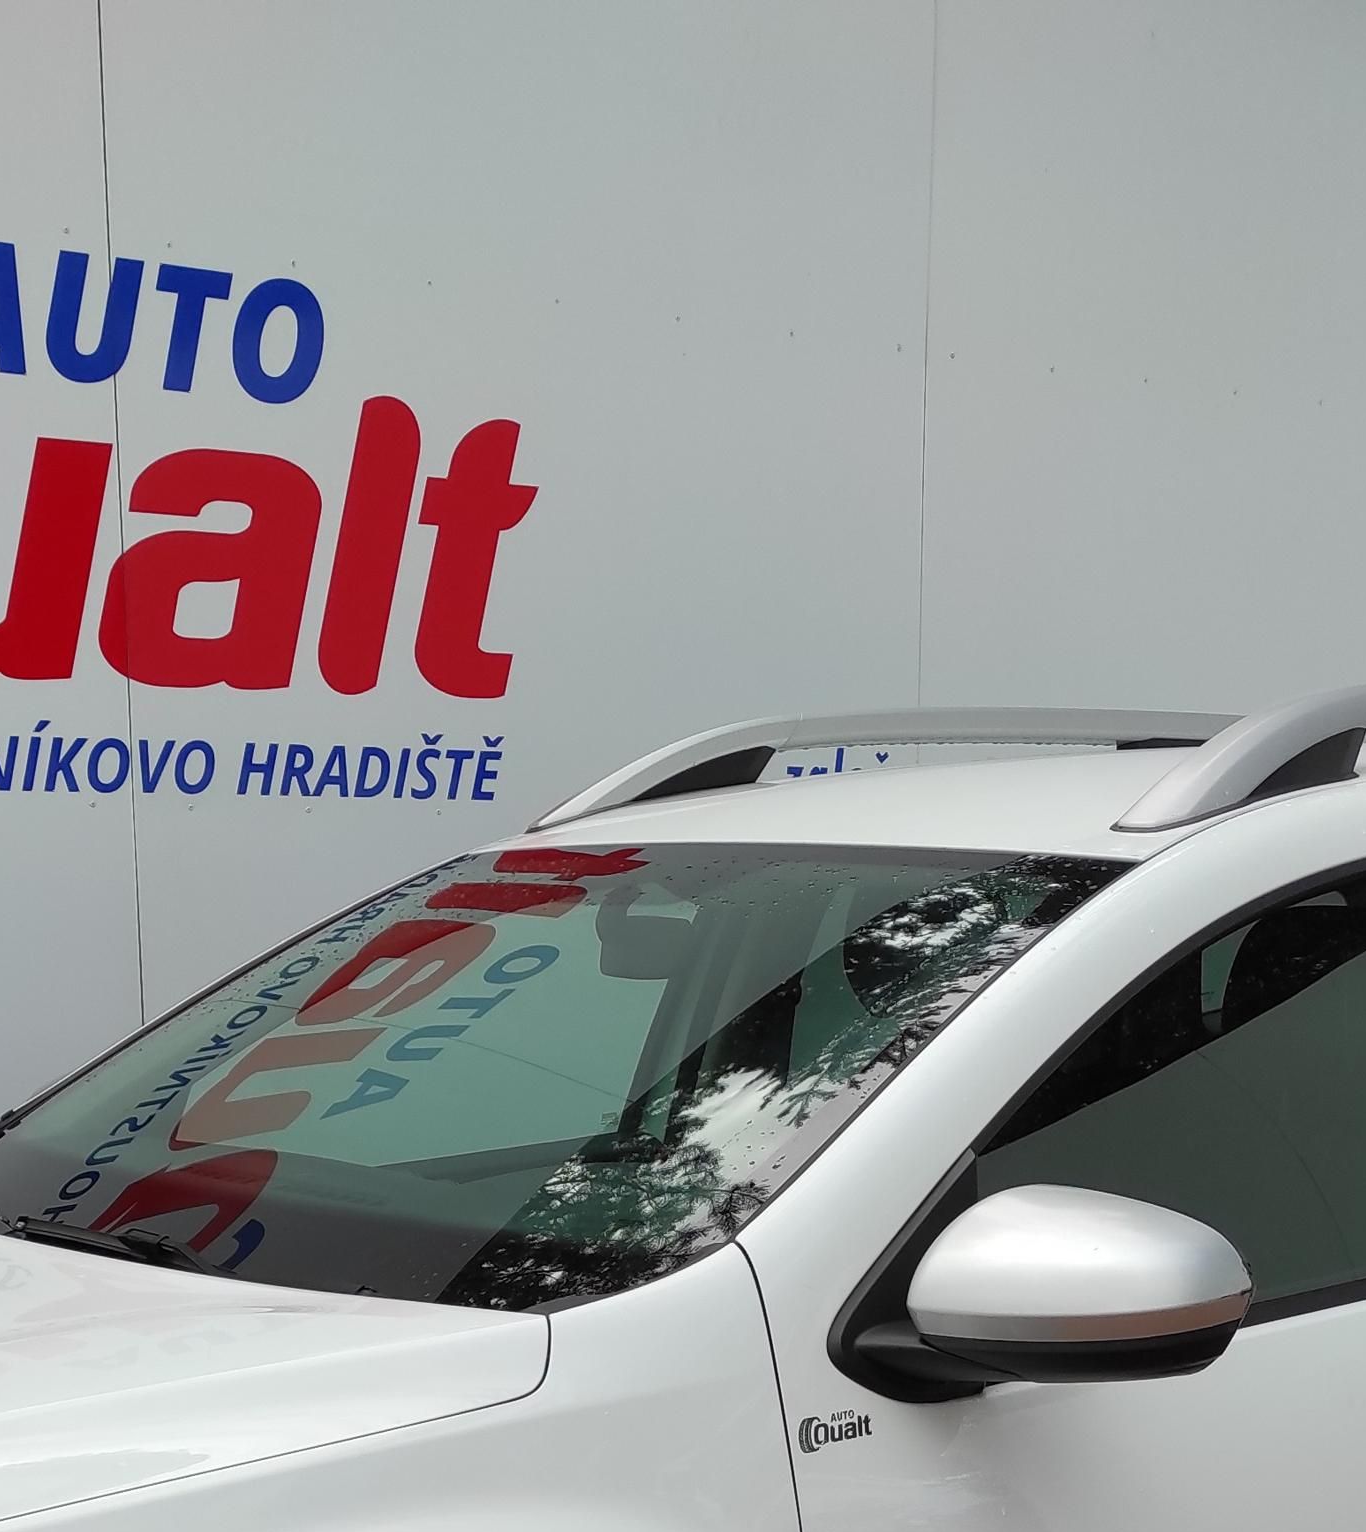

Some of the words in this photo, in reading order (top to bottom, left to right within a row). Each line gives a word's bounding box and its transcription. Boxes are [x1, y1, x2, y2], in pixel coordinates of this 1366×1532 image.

[238, 734, 504, 802] HRADIŠTĚ
[814, 1415, 872, 1445] Qualt
[830, 1409, 855, 1422] AUTO
